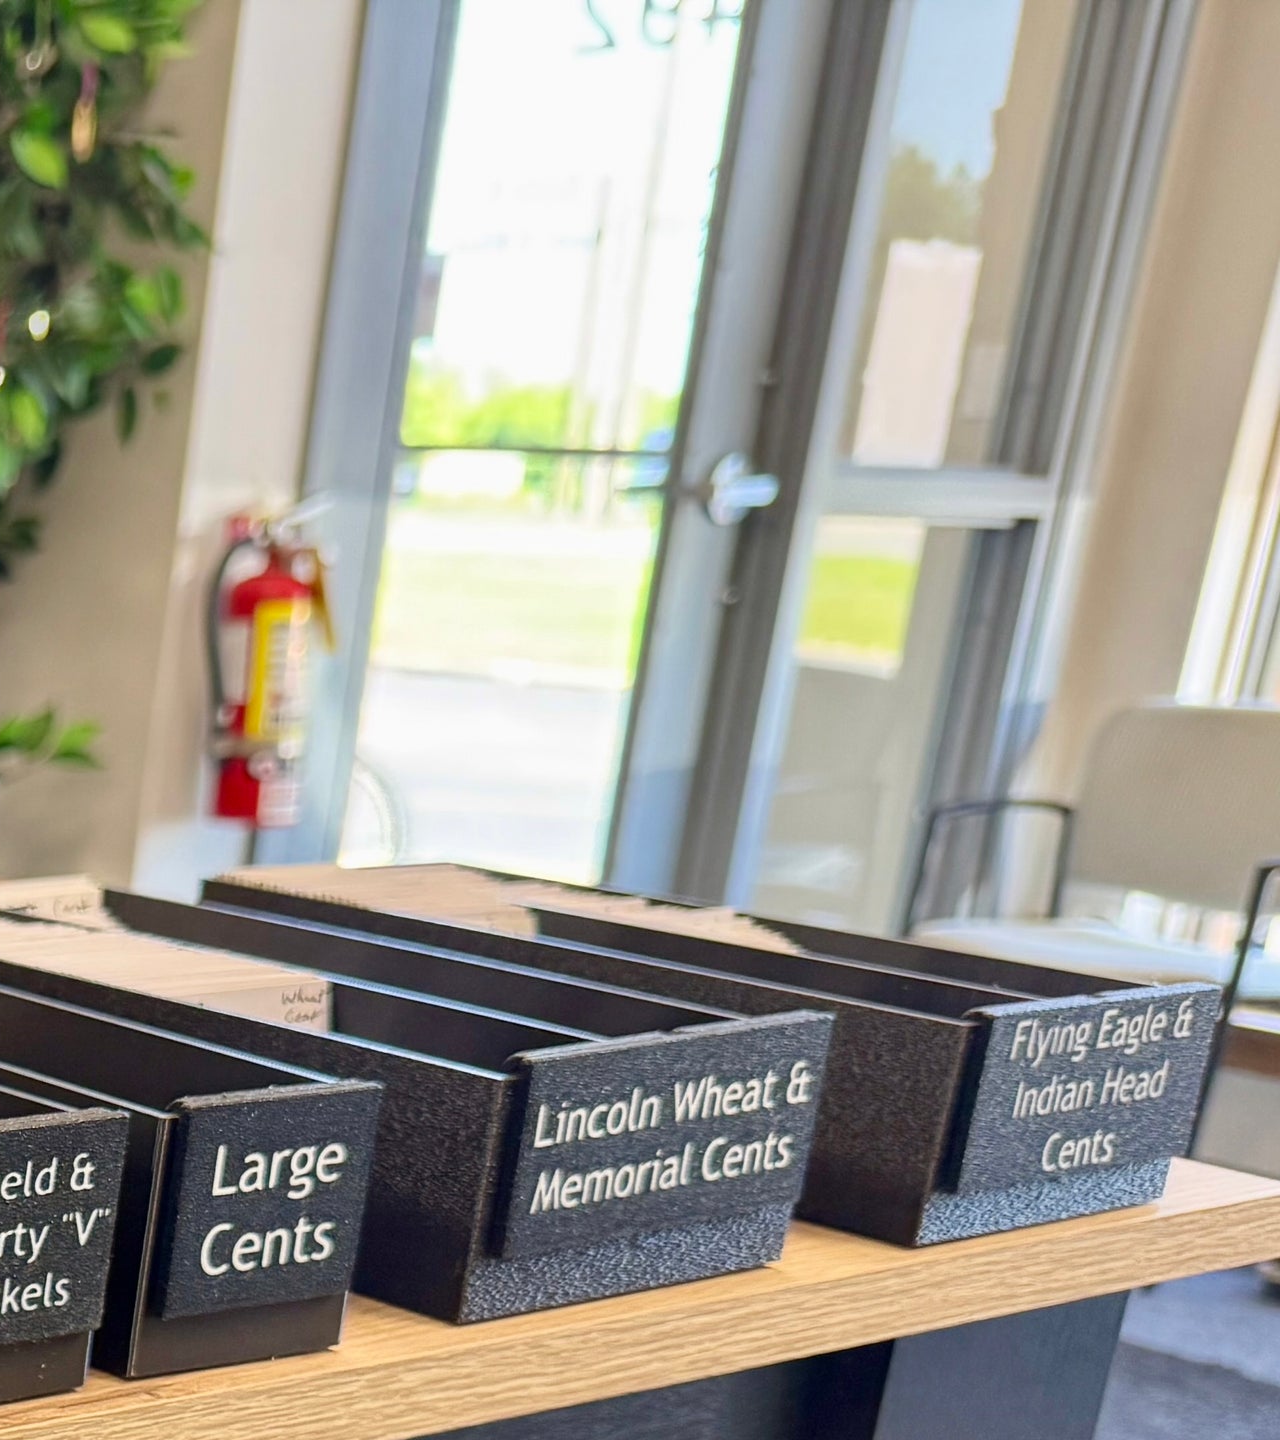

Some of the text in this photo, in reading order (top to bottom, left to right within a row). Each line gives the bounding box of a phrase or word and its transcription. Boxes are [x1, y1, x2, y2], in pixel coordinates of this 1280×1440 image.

[1009, 997, 1195, 1069] Flying Eagle &
[534, 1060, 814, 1149] Lincoln Wheat &
[1012, 1058, 1171, 1120] Indian Head
[69, 1153, 95, 1191] &
[212, 1143, 347, 1199] Large
[530, 1131, 794, 1216] Memorial Cents
[1042, 1129, 1118, 1173] Cents
[62, 1208, 112, 1247] "V"
[201, 1217, 336, 1276] Cents
